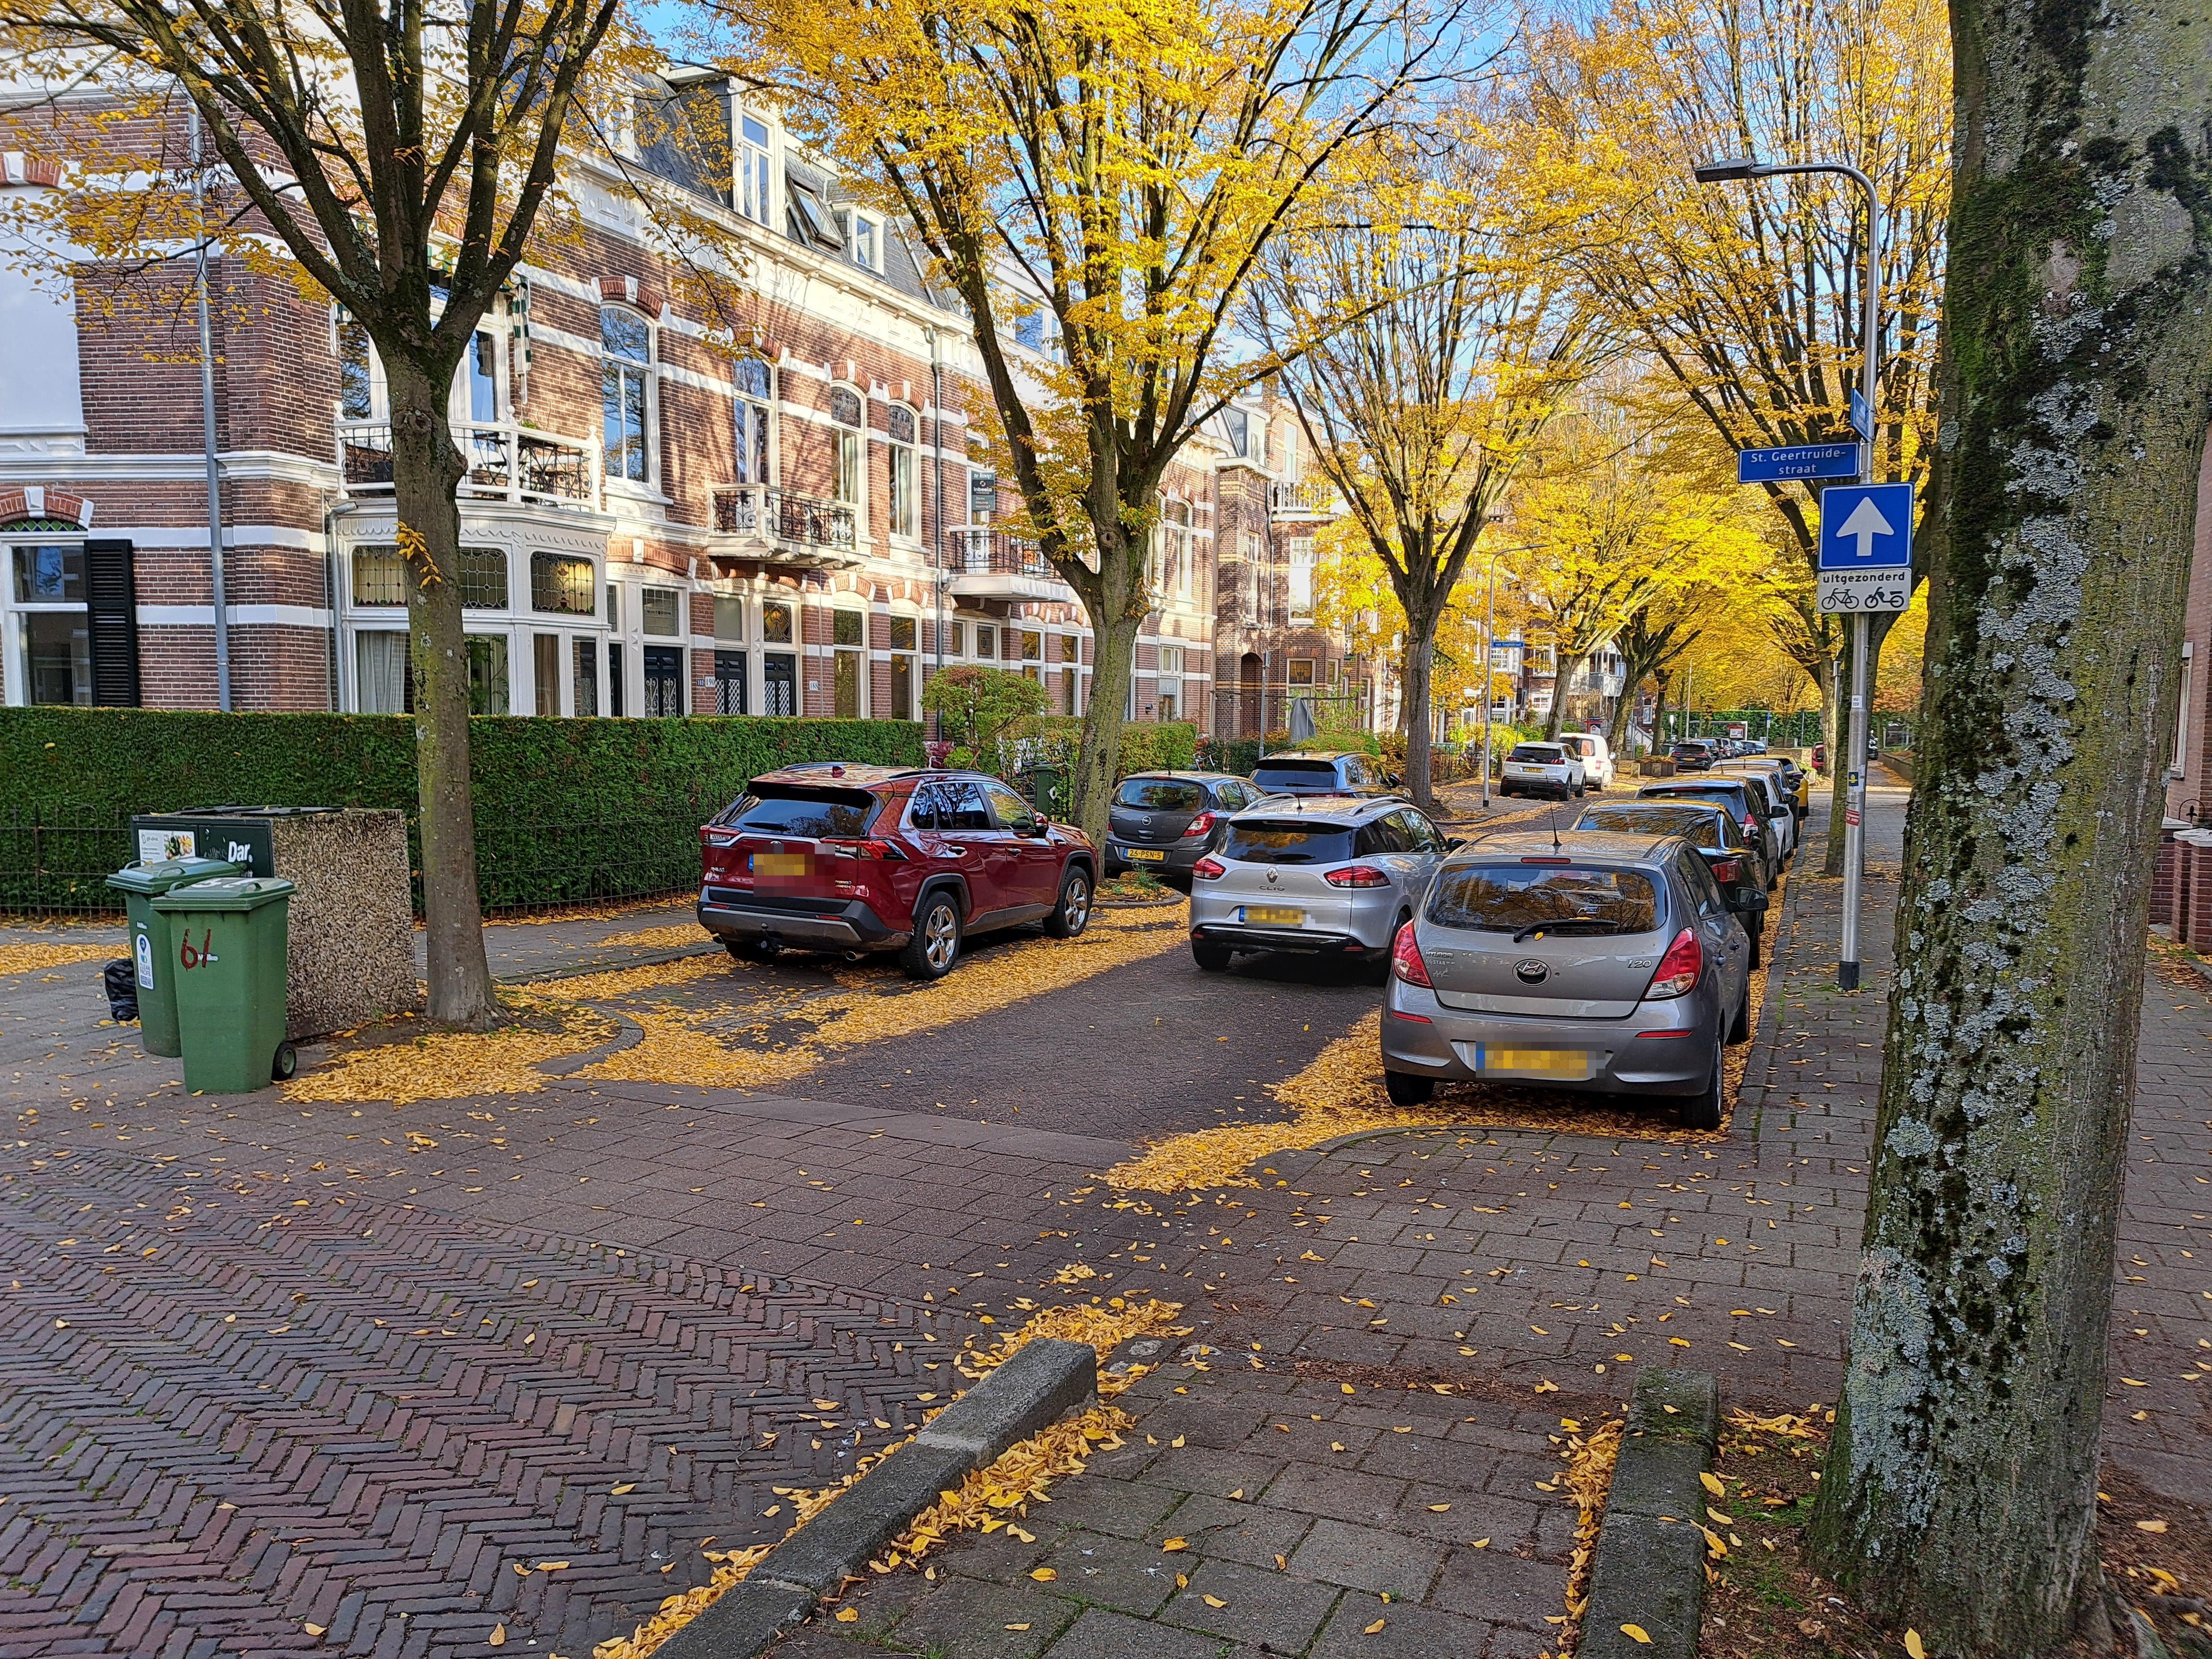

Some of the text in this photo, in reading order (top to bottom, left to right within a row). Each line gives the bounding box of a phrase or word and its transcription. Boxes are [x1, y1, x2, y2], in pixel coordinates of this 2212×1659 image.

[1750, 448, 1846, 463] St. Geertruide-
[1778, 464, 1817, 475] straat
[1823, 572, 1905, 584] uitgezonderd
[1627, 959, 1652, 968] i20
